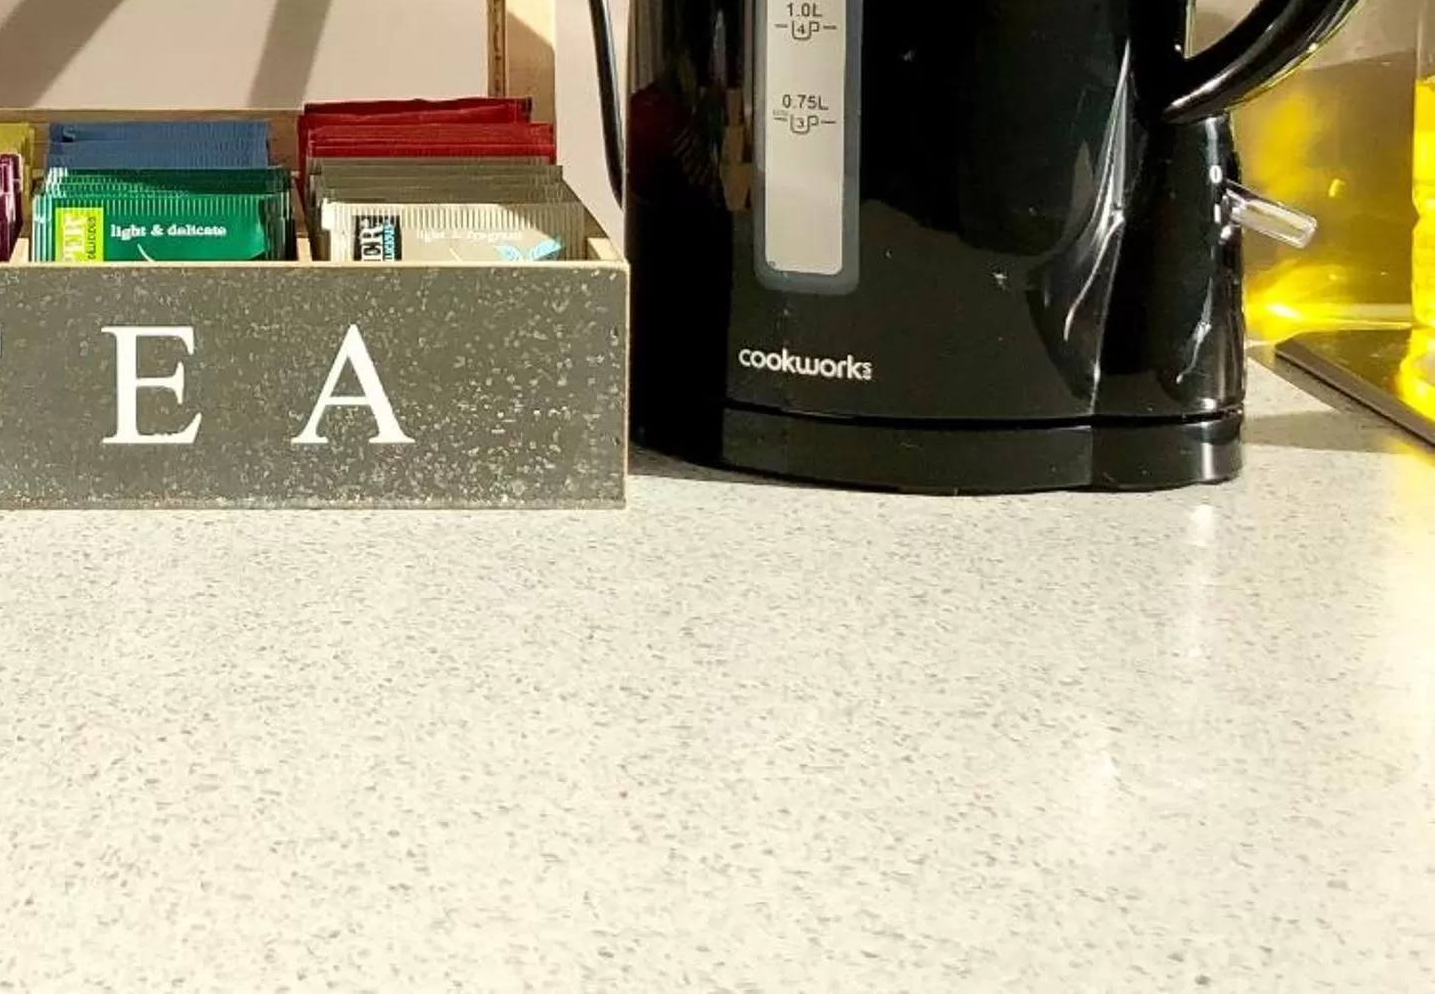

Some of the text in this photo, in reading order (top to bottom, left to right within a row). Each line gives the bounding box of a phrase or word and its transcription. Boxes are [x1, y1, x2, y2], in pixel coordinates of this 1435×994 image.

[787, 3, 823, 17] 1.0L
[782, 94, 828, 110] 0.75L
[110, 224, 227, 241] light & delicate
[738, 347, 873, 381] cookworks
